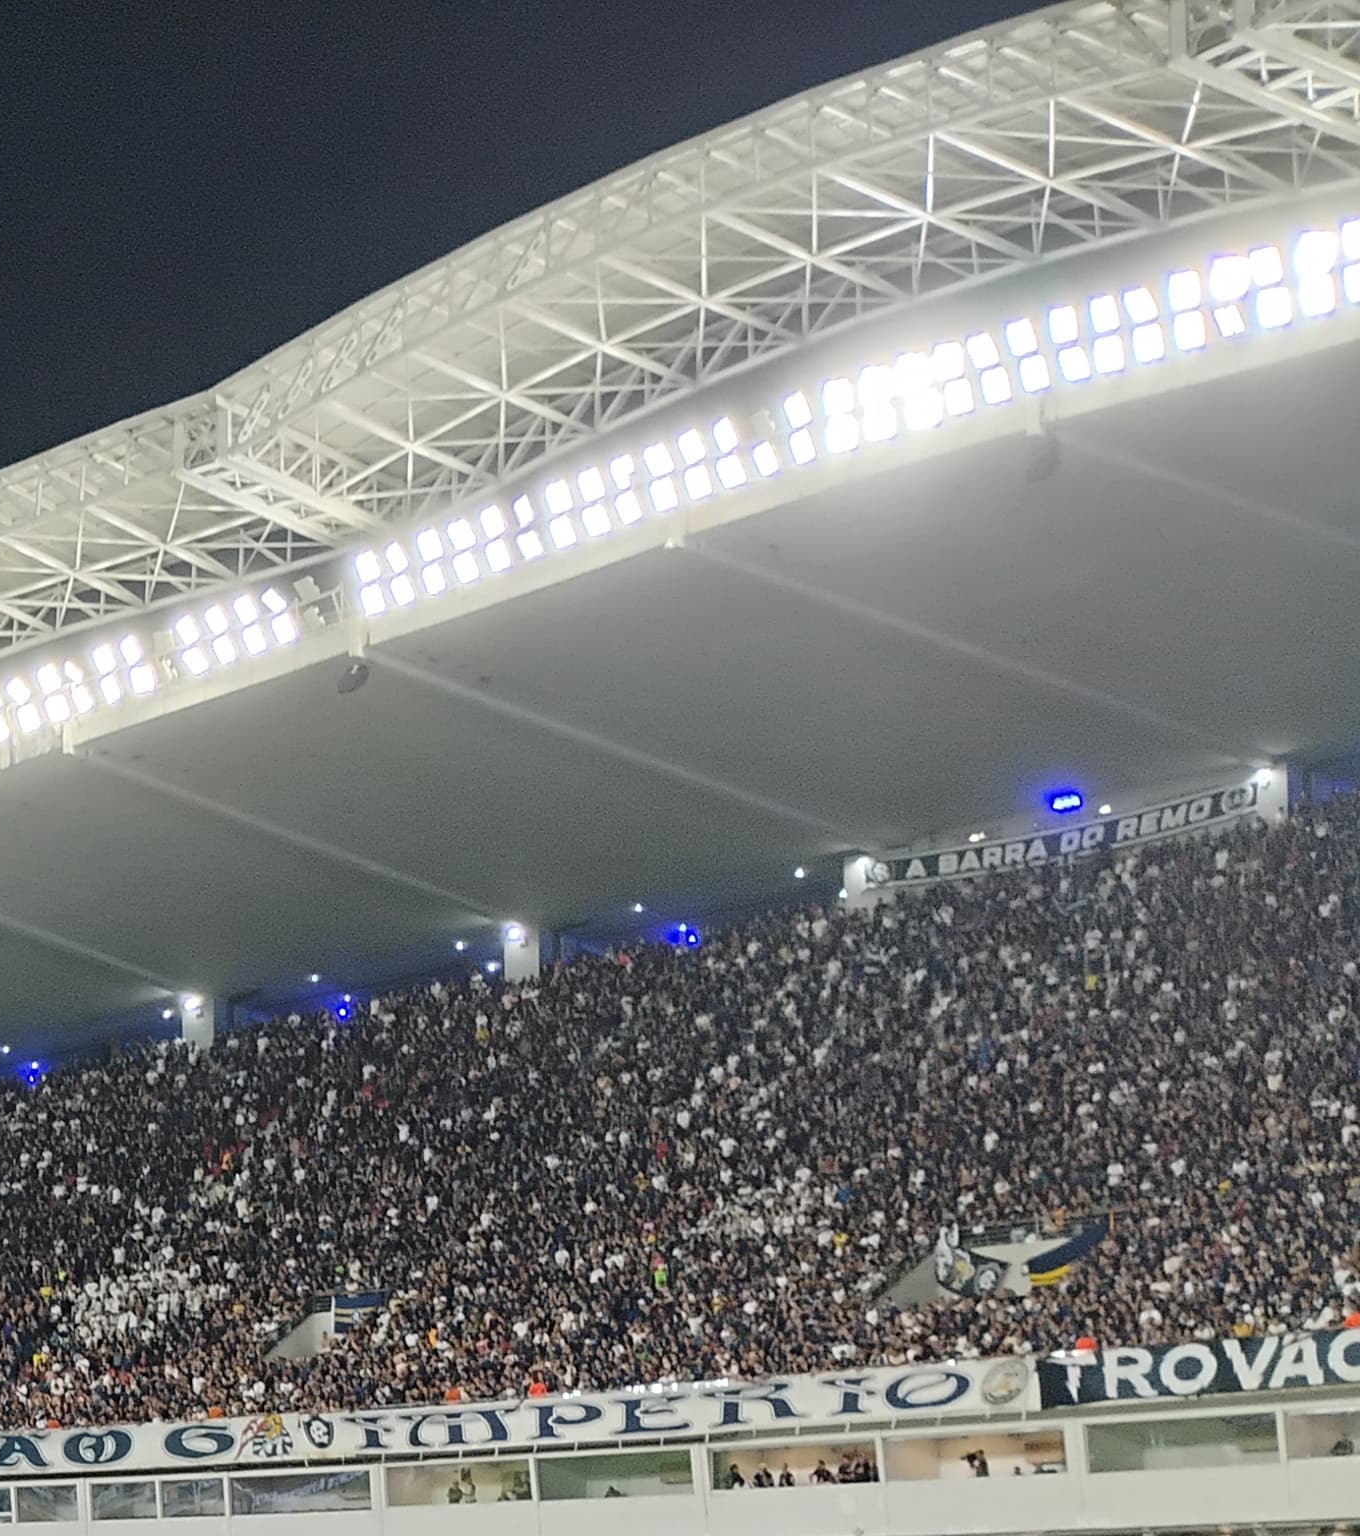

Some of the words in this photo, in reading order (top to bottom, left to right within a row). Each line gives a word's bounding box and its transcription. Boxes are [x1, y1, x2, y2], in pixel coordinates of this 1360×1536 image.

[906, 859, 926, 879] A
[937, 836, 1048, 875] BARRA
[1059, 822, 1106, 853] DO
[1117, 797, 1214, 841] REMO
